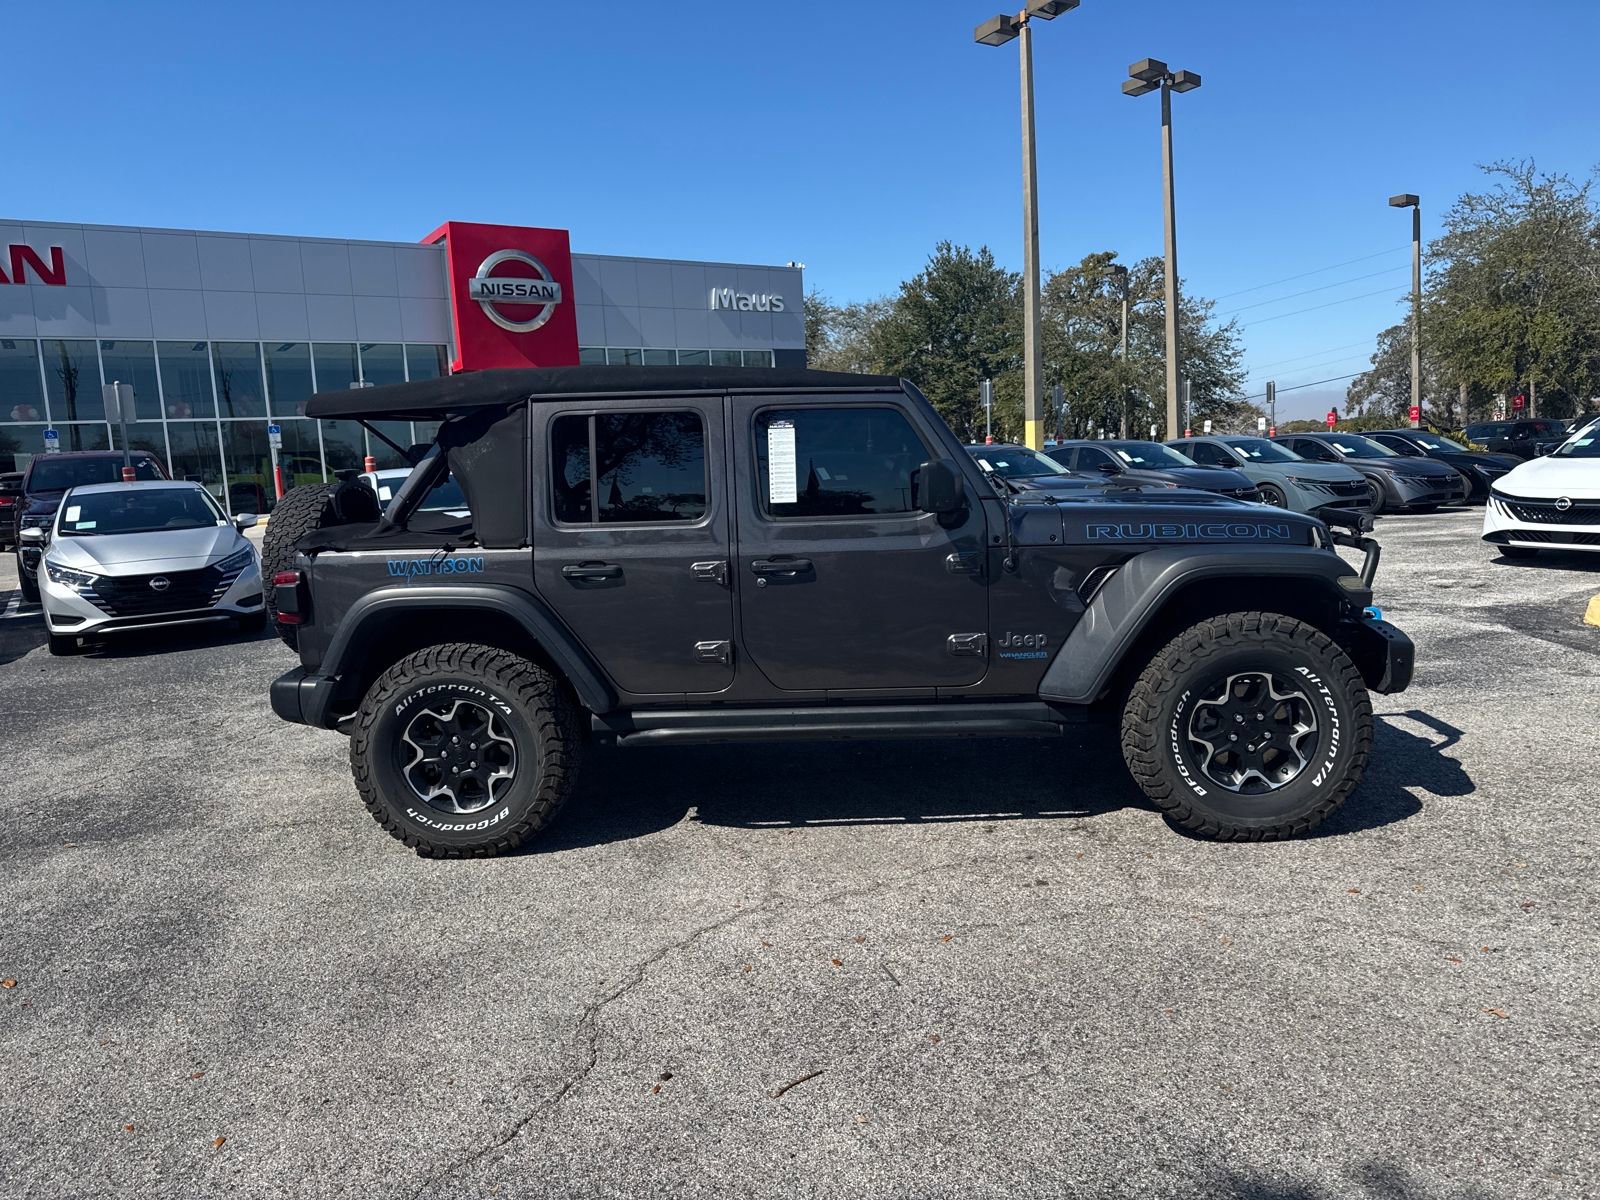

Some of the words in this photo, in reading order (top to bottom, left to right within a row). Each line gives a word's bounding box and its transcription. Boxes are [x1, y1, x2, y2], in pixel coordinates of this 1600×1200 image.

[0, 244, 67, 287] N
[480, 282, 555, 299] NISSAN
[711, 287, 785, 312] Maus
[1086, 523, 1291, 540] RUBICON
[387, 557, 485, 577] WATTSON
[998, 631, 1048, 650] Jeep
[394, 683, 487, 717] All-Terrain
[488, 694, 513, 716] T/A
[1294, 665, 1341, 758] All-Terrain
[1169, 689, 1209, 797] BFGoodrich
[1311, 759, 1336, 788] T/A
[406, 806, 511, 832] BFGoodrich
